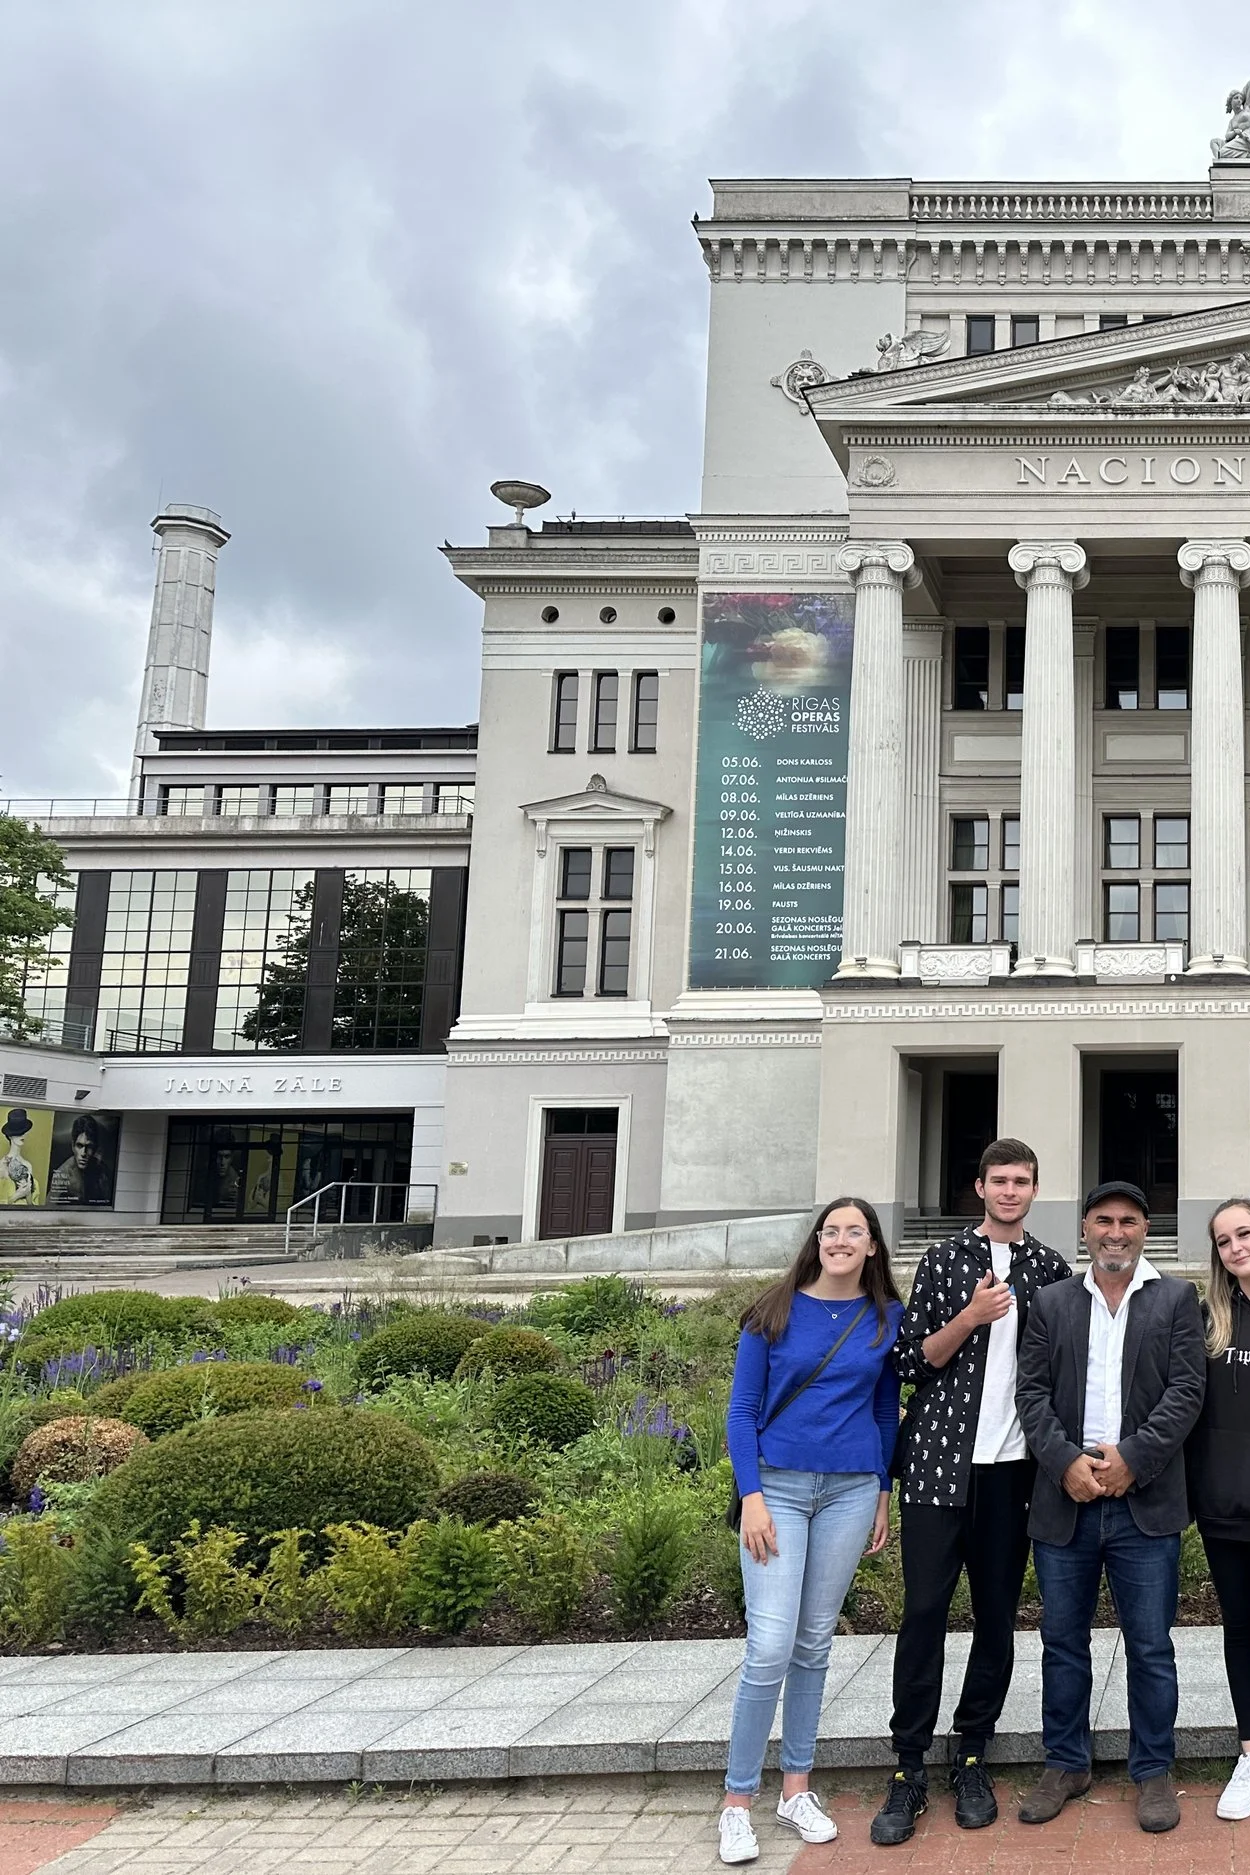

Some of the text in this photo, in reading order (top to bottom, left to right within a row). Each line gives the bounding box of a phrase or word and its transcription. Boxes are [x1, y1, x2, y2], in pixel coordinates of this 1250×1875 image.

[791, 695, 841, 711] RĪGAS
[791, 711, 841, 722] OPERAS
[791, 722, 840, 733] FESTIVĀLS
[721, 756, 833, 768] 05.06. DONS KARLOSS
[721, 774, 759, 786] 07.06.
[720, 792, 834, 803] 08.06. MĪLAS DZĒRIENS
[720, 810, 846, 821] 09.06. VELTĪGĀ UZMANĪBA
[721, 827, 812, 839] 12.06. ŅIŽINSKIS
[720, 845, 757, 857] 14.06.
[796, 846, 833, 854] REKVIĒMS
[719, 863, 757, 875] 15.06.
[792, 863, 824, 872] ŠAUSMU
[718, 881, 832, 893] 16.06. MĪLAS DZĒRIENS
[718, 899, 755, 911] 19.06.
[715, 922, 757, 934] 20.06.
[771, 924, 792, 932] GALĀ
[714, 947, 831, 961] 21.06. GALĀ KONCERTS
[164, 1076, 343, 1094] JAUNĀ ZĀLE
